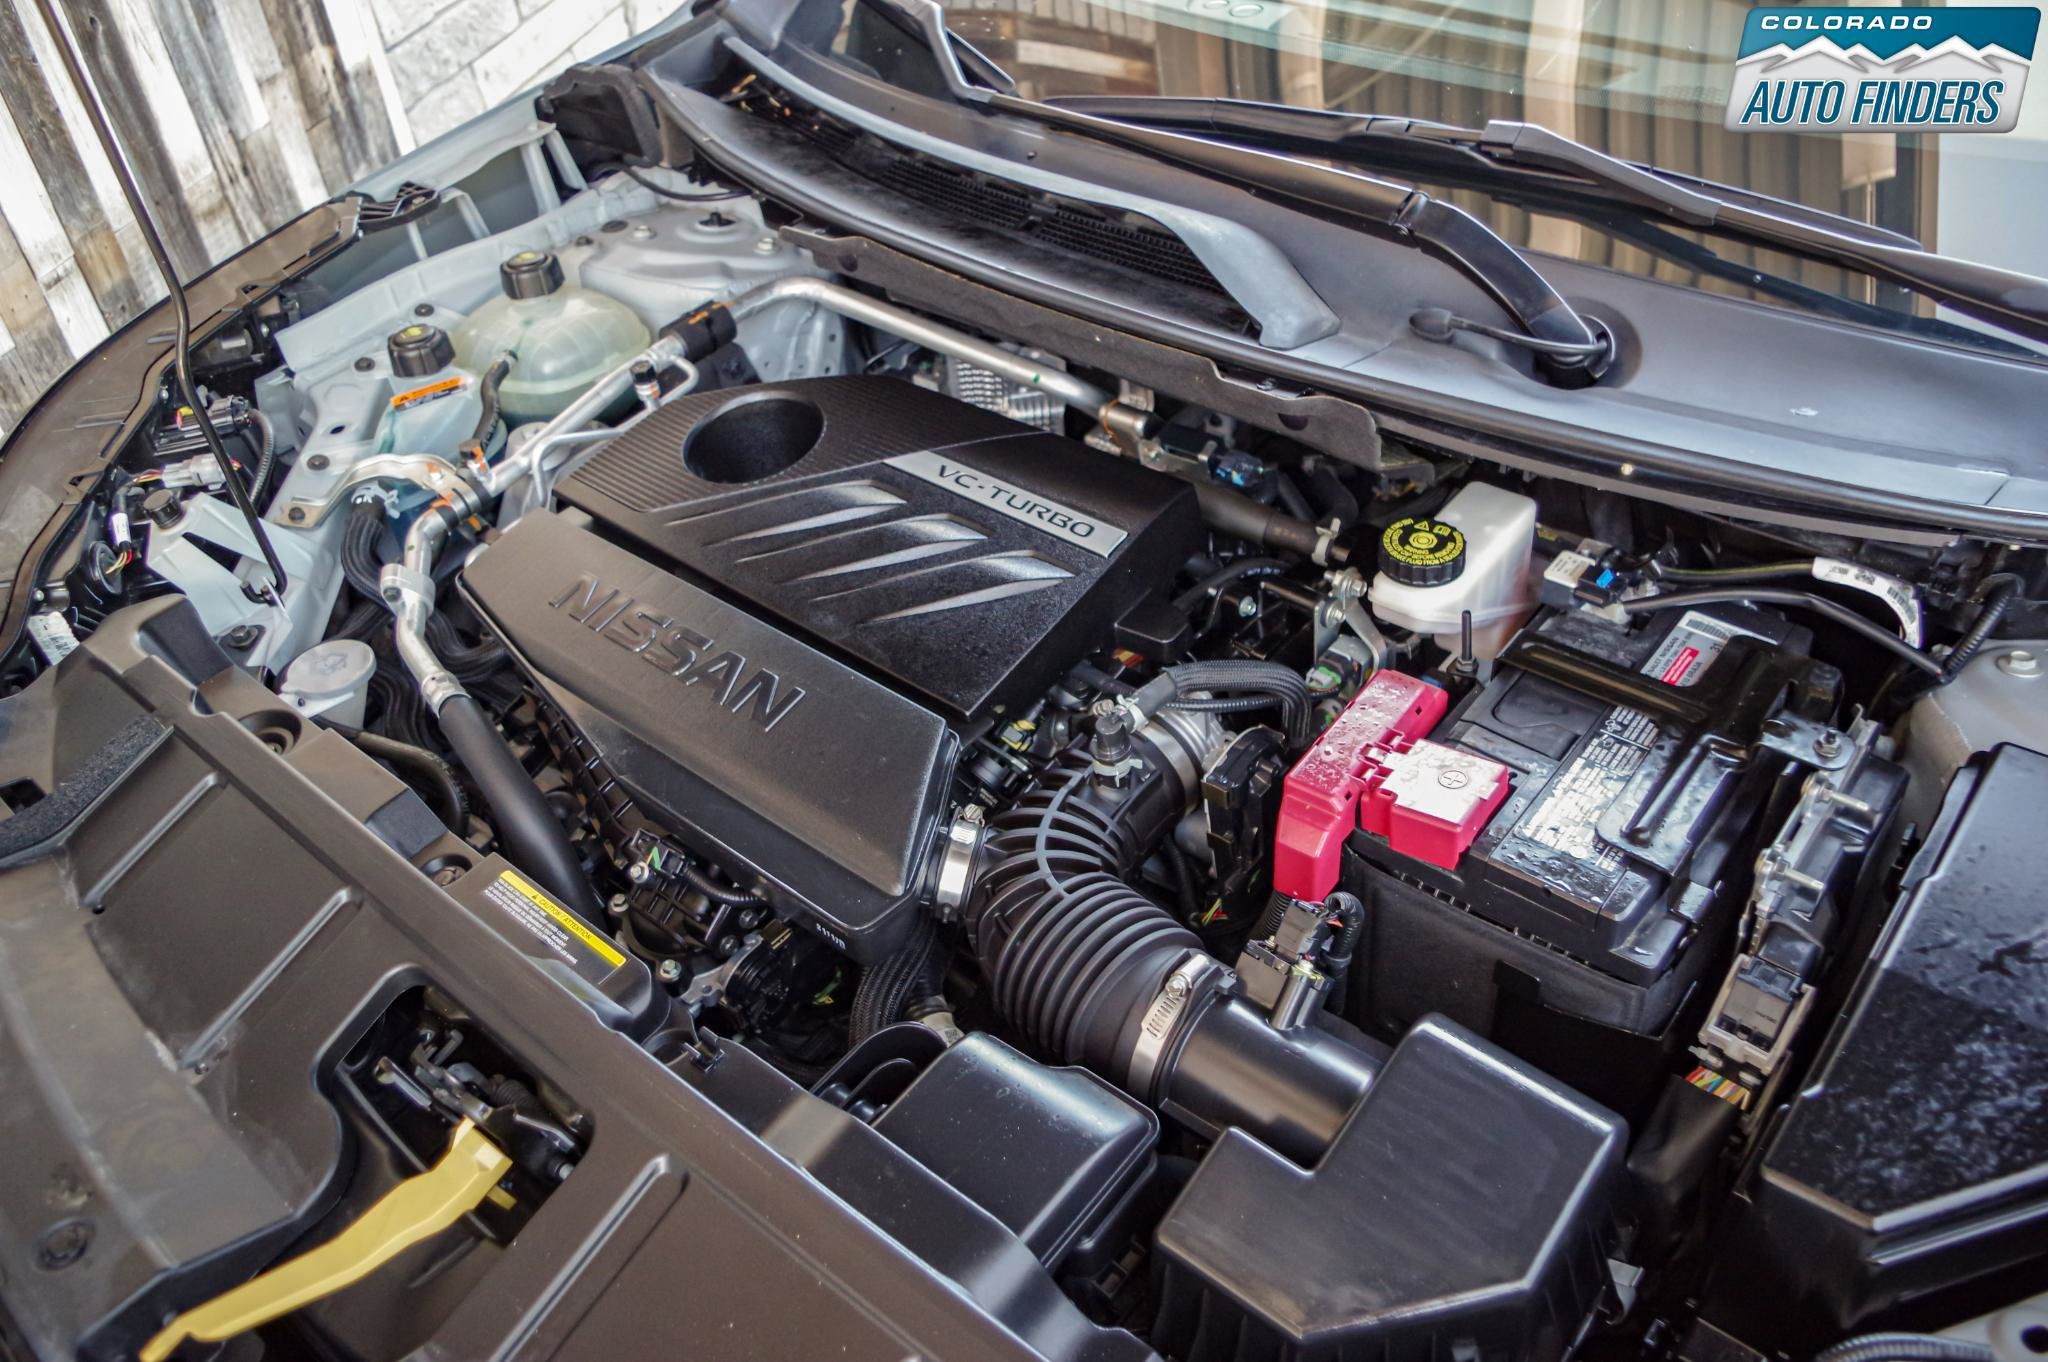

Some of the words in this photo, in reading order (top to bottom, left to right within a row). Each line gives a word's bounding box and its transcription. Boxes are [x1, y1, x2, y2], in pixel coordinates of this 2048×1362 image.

[936, 463, 1096, 540] VC-TURBO
[547, 571, 806, 732] NISSAN
[539, 899, 561, 916] CAUTION
[563, 916, 592, 941] ATTENTION
